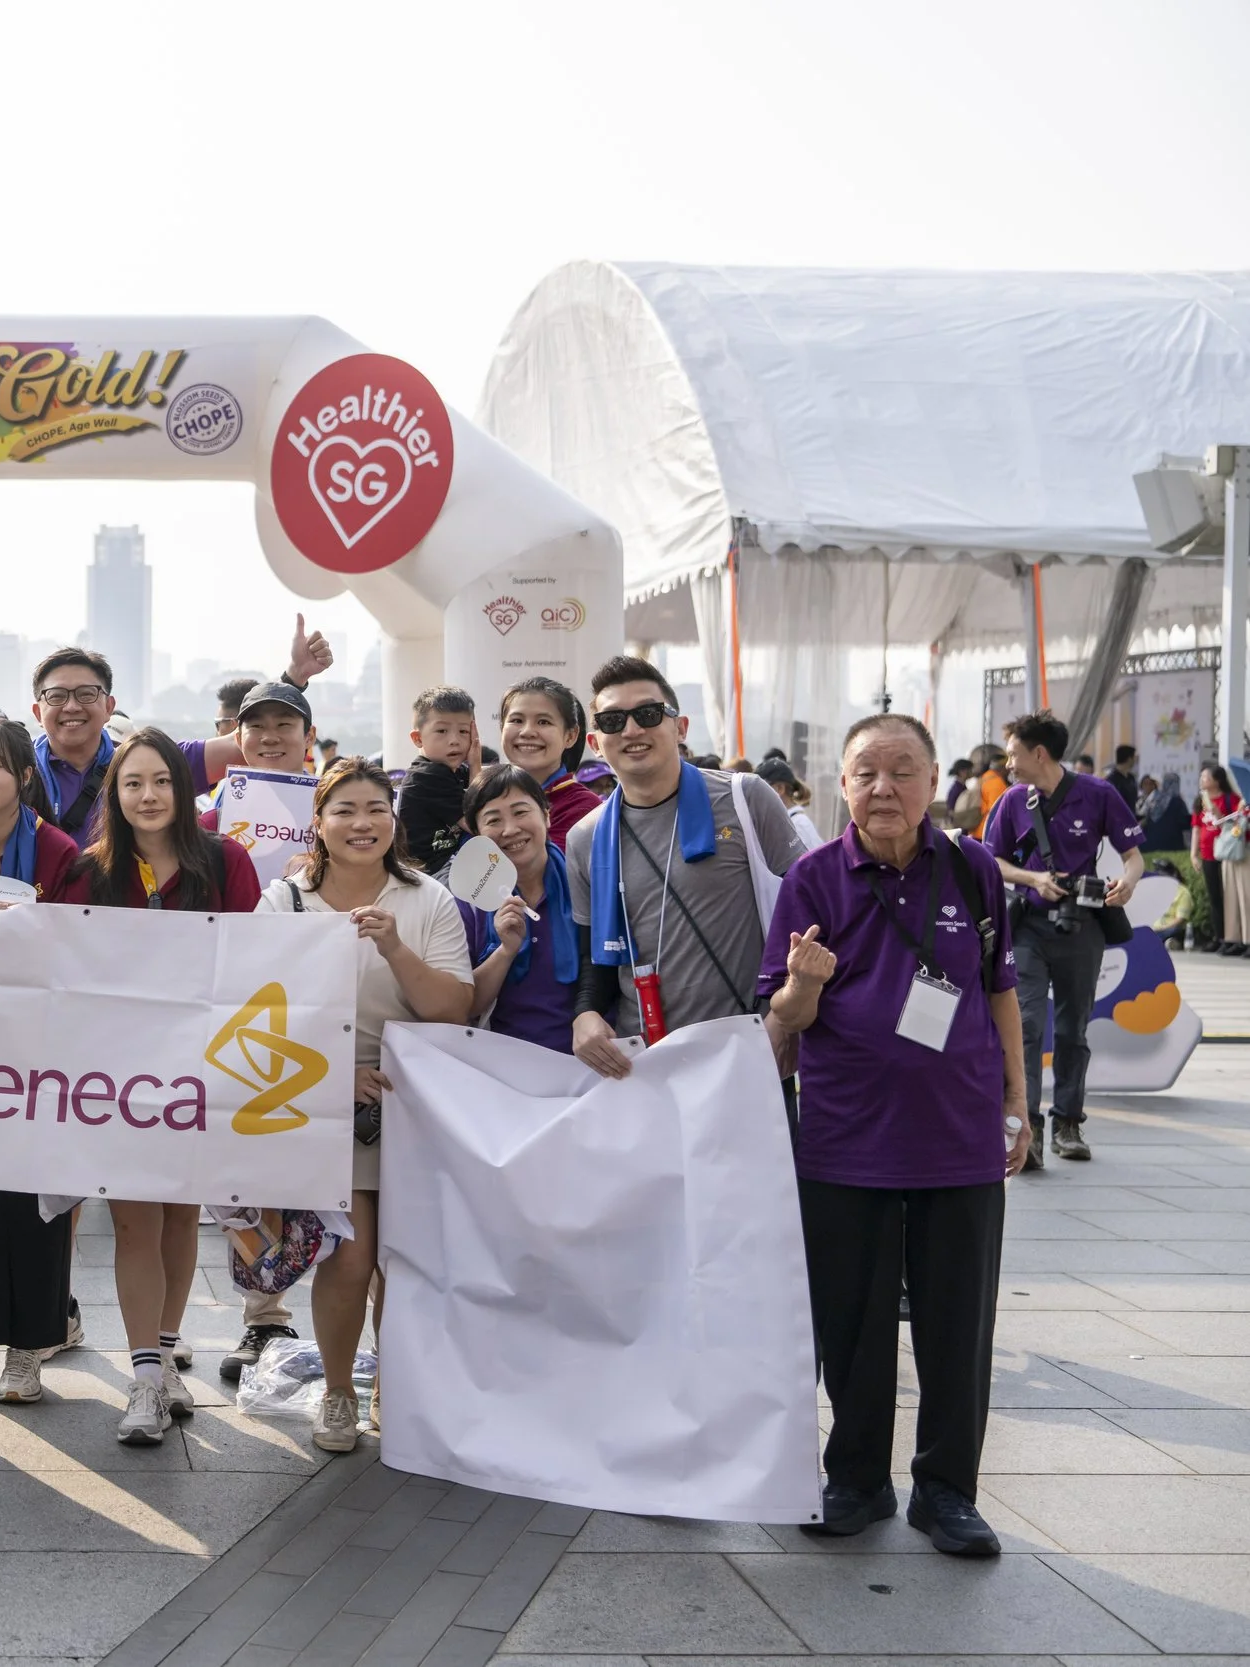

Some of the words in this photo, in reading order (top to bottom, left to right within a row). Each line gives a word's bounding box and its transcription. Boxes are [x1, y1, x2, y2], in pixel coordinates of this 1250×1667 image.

[173, 391, 199, 421] BLOSSOM
[201, 390, 225, 402] SEEDS
[26, 425, 67, 449] CHOPE,
[69, 421, 91, 432] Age
[93, 418, 118, 428] Well
[173, 403, 236, 440] CHOPE
[287, 384, 440, 469] Healthier
[326, 460, 388, 506] SG
[512, 577, 547, 585] Supported
[482, 594, 527, 616] Healthier
[495, 614, 513, 625] SG
[524, 660, 567, 668] Administrator
[471, 863, 497, 900] AstraZeneca
